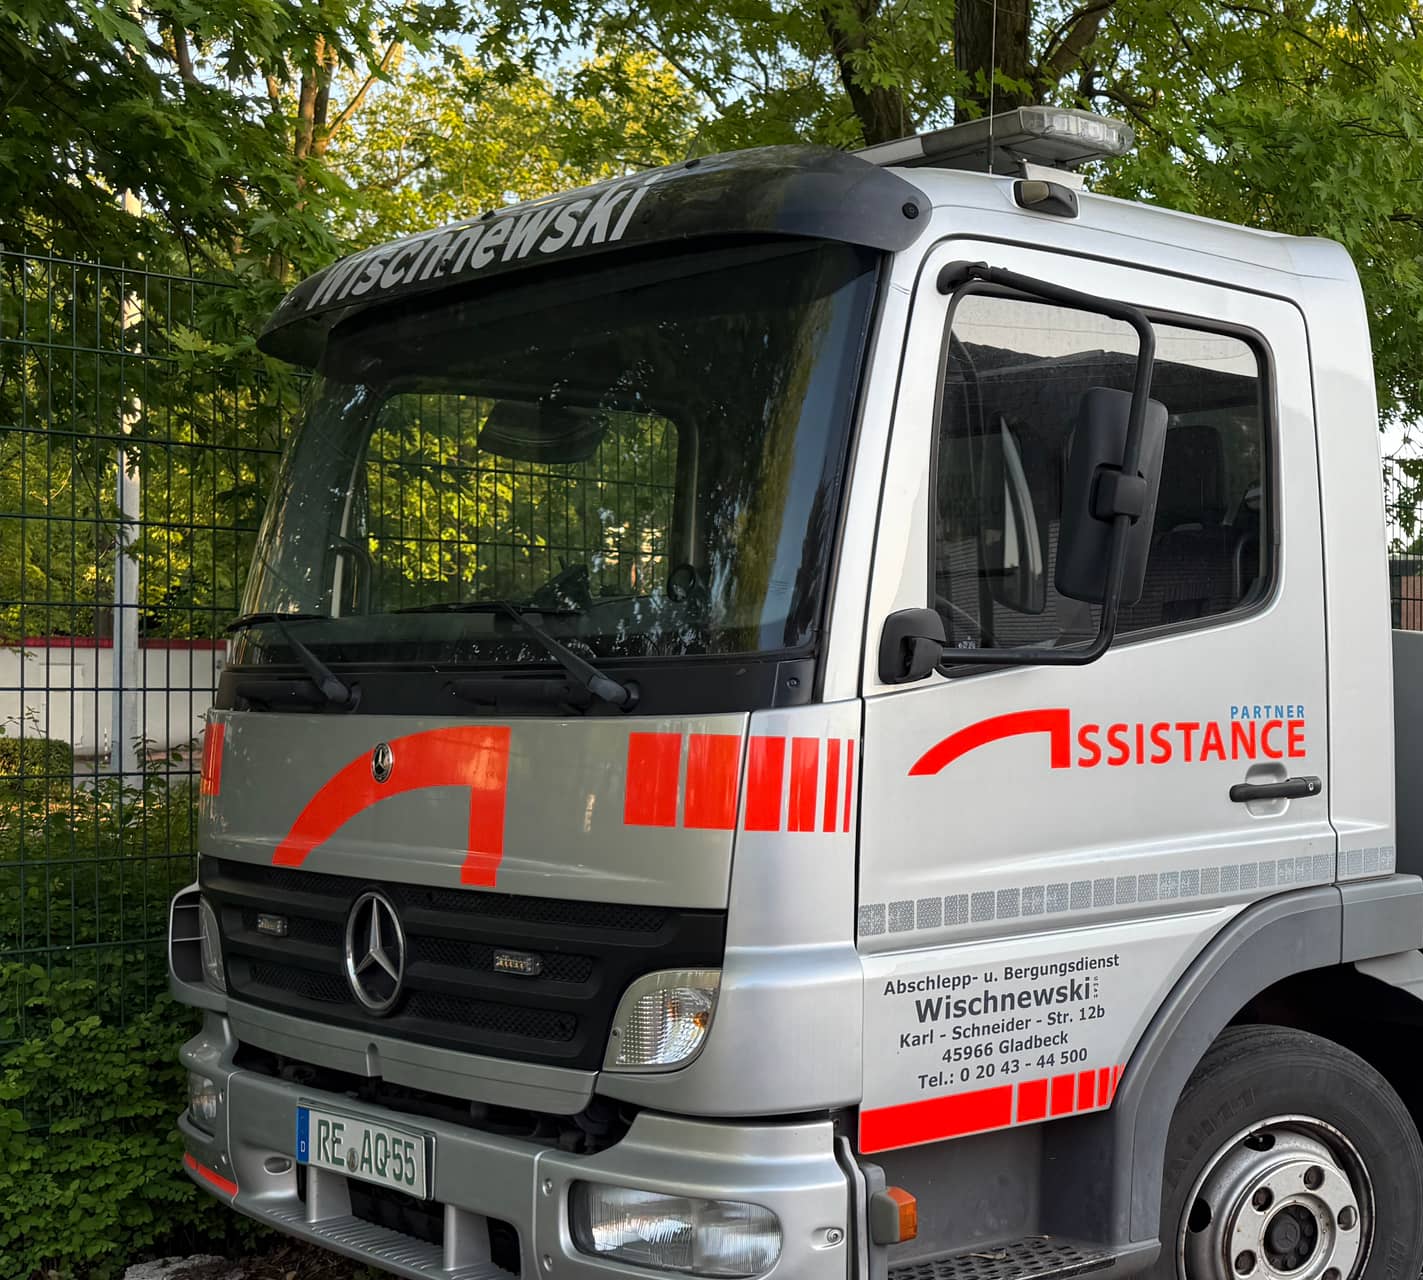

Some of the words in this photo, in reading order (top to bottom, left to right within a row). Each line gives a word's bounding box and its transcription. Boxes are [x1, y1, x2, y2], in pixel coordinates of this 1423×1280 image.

[305, 173, 663, 311] Wischnewski
[1230, 704, 1305, 720] PARTNER
[884, 974, 978, 996] Abschlepp-
[984, 971, 999, 984] u.
[1004, 953, 1120, 981] Bergungsdienst
[915, 976, 1090, 1023] Wischnewski
[900, 1029, 934, 1049] Karl
[952, 1017, 1032, 1041] Schneider
[1047, 1010, 1073, 1026] Str.
[1079, 1004, 1105, 1022] 12b
[942, 1041, 993, 1063] 45966
[999, 1030, 1069, 1055] Gladbeck
[918, 1072, 954, 1089] Tel.:
[960, 1067, 970, 1082] 0
[976, 1062, 995, 1080] 20
[1000, 1058, 1020, 1075] 43
[1036, 1053, 1055, 1069] 44
[1060, 1047, 1088, 1066] 500
[300, 1140, 306, 1153] D
[317, 1119, 345, 1166] RE
[360, 1129, 388, 1178] AQ
[392, 1137, 416, 1186] 55
